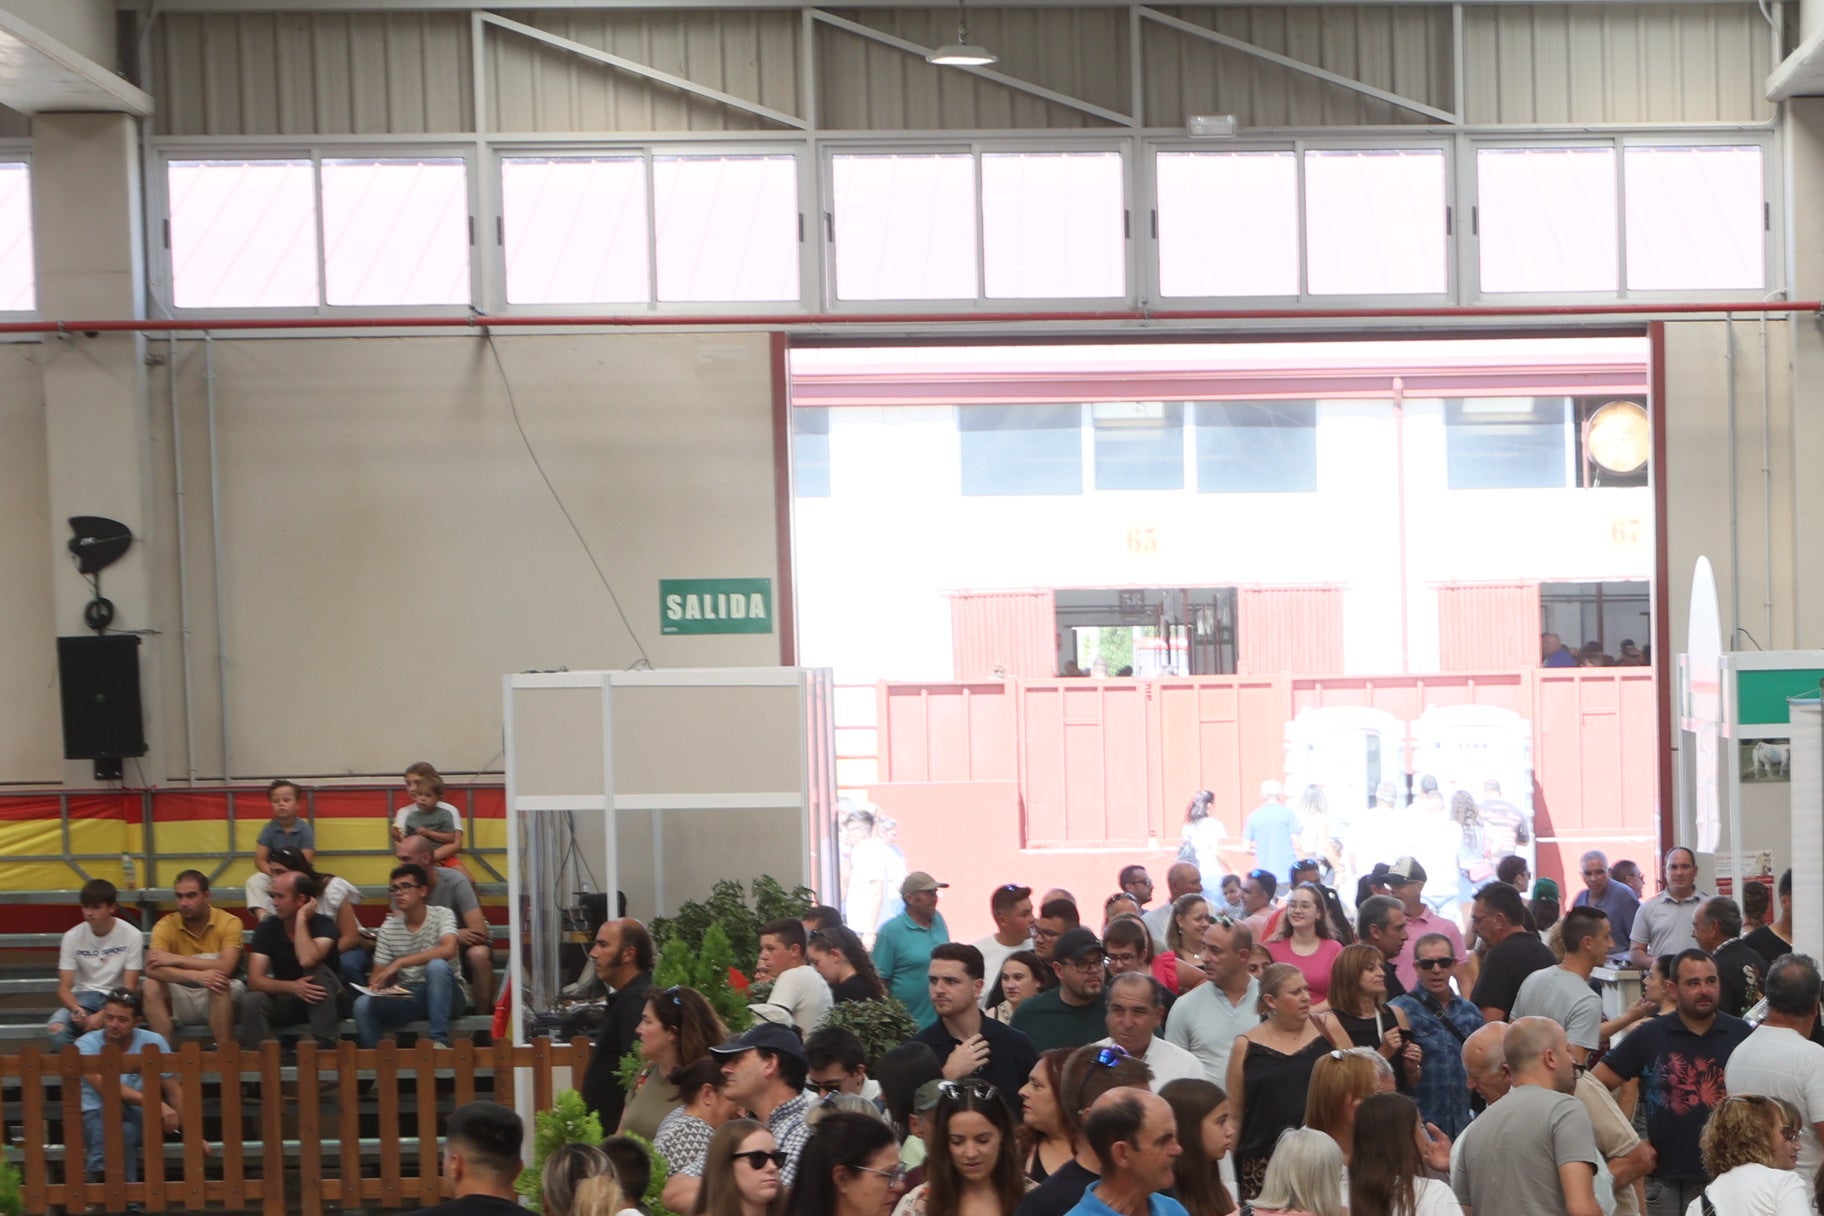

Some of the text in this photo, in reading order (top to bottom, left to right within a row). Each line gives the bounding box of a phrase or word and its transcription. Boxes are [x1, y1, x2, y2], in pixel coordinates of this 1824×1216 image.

[1127, 527, 1157, 553] 65
[666, 593, 767, 620] SALIDA
[76, 945, 128, 957] POLO SPORT
